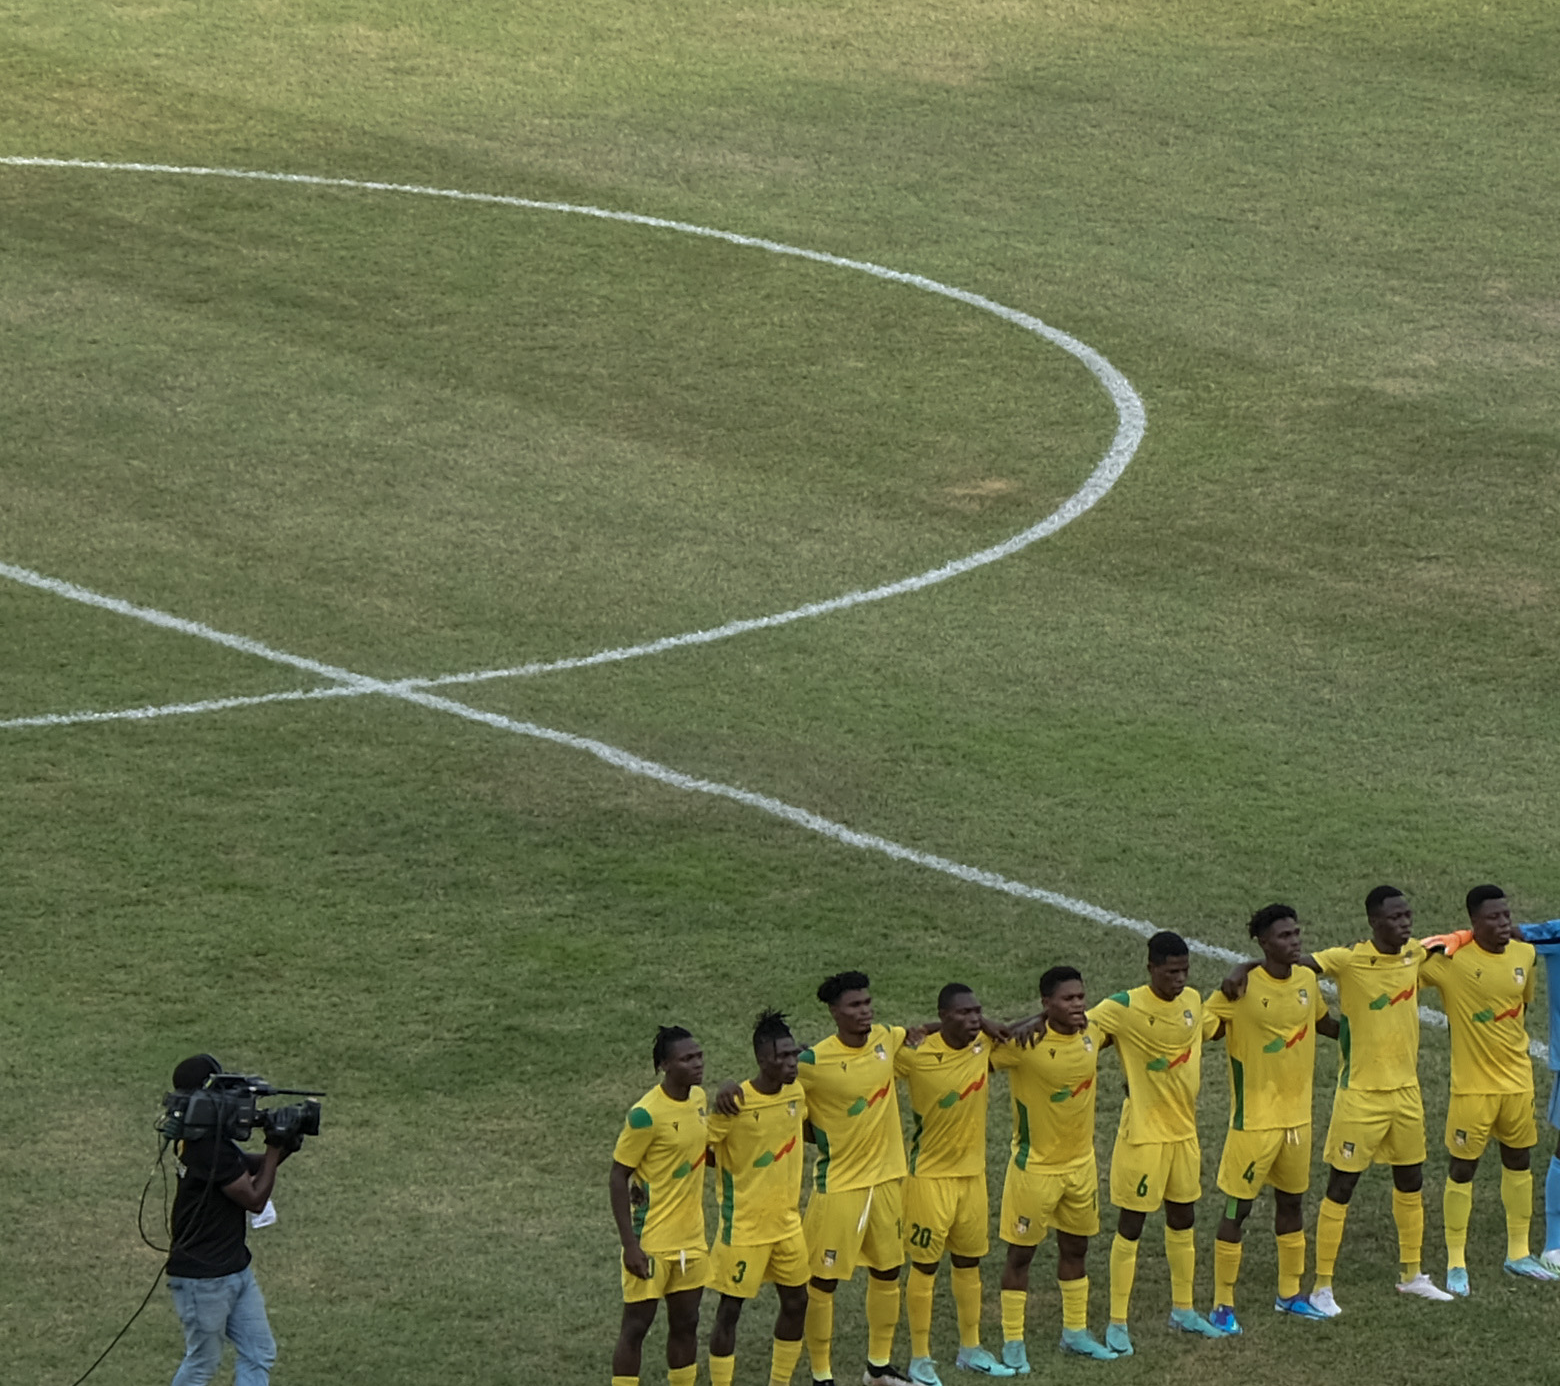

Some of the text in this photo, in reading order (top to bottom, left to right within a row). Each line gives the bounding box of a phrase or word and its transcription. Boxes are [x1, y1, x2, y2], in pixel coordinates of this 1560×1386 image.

[1242, 1161, 1257, 1184] 4
[1136, 1174, 1148, 1197] 6
[910, 1223, 932, 1249] 20
[732, 1260, 747, 1283] 3
